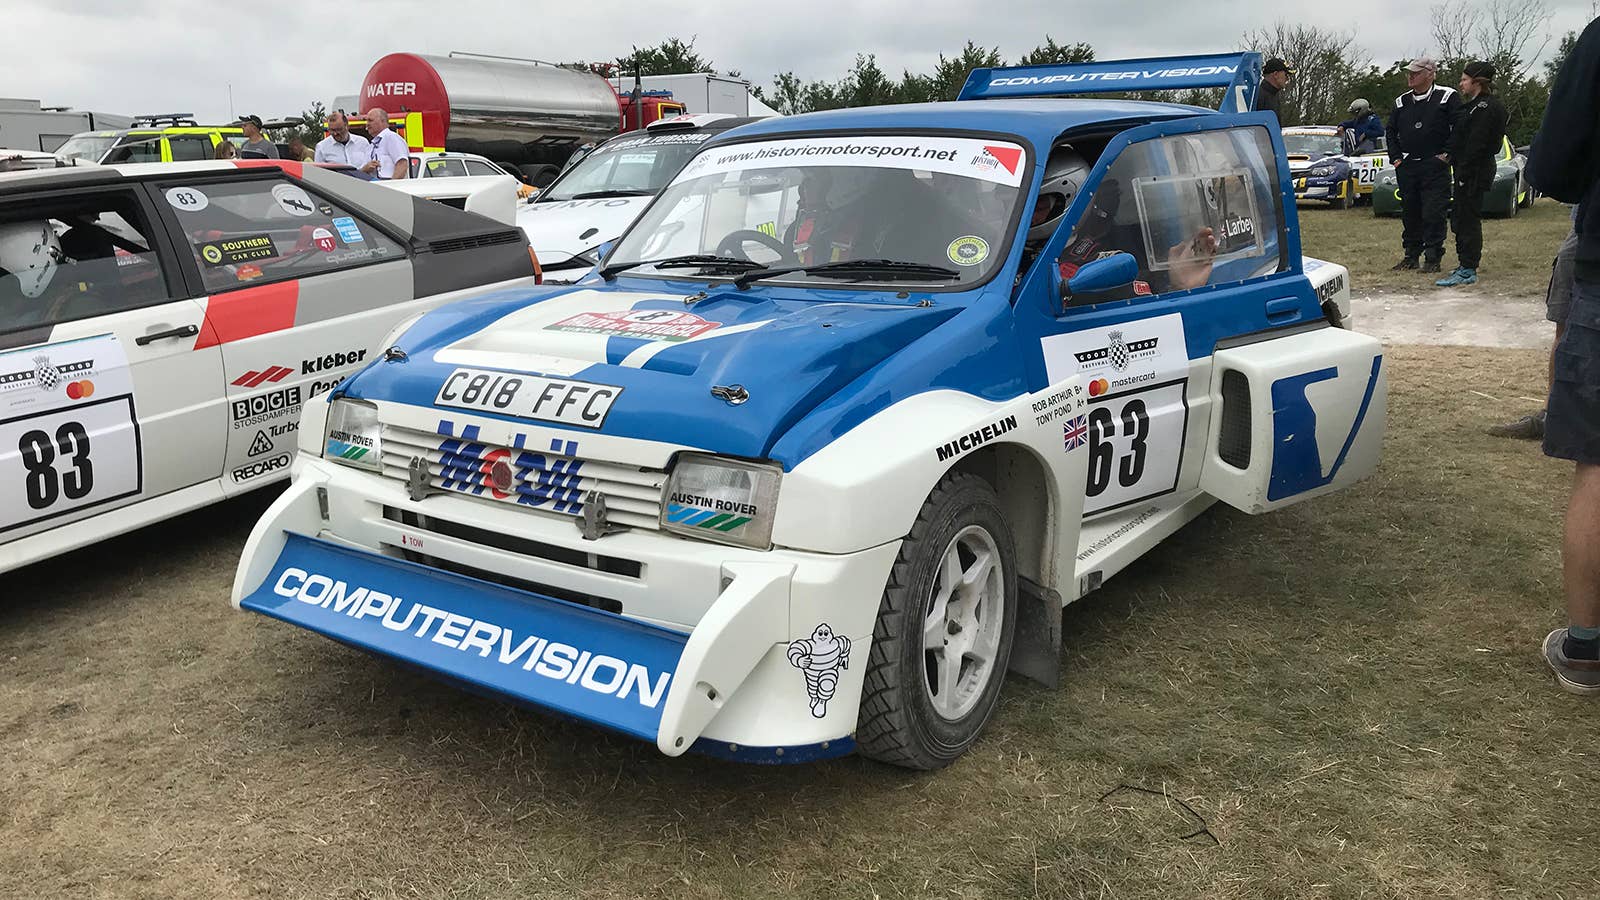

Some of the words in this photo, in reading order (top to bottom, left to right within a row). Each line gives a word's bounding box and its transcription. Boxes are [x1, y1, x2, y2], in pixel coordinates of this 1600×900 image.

[989, 65, 1239, 87] COMPUTERVISION
[367, 82, 417, 98] WATER
[716, 144, 959, 166] www.historicmotorsport.net
[176, 192, 197, 205] 83
[1225, 216, 1254, 237] Larbey
[221, 237, 271, 251] SOUTHERN
[231, 251, 249, 261] CAR
[252, 249, 271, 259] CLUB
[320, 239, 333, 249] 41
[325, 246, 388, 264] quattro
[1315, 274, 1344, 302] ICHELIN
[1079, 350, 1107, 361] GOOD
[1129, 340, 1156, 350] WOOD
[61, 361, 91, 373] WOOD
[301, 349, 367, 375] kléber
[1082, 360, 1109, 370] FESTIVAL
[1111, 371, 1156, 388] mastercard
[234, 387, 300, 420] BOGE
[441, 371, 516, 409] C818
[532, 383, 614, 422] FFC
[1032, 399, 1048, 413] ROB
[1048, 388, 1074, 407] ARTHUR
[1074, 385, 1083, 395] B+
[234, 404, 302, 430] STOSSDAMPFER
[1036, 411, 1054, 427] TONY
[1054, 403, 1072, 420] POND
[1077, 399, 1085, 408] A+
[329, 429, 351, 442] AUSTIN
[352, 434, 374, 447] ROVER
[936, 415, 1018, 462] MICHELIN
[1086, 399, 1150, 498] 63
[18, 421, 94, 510] 83
[233, 454, 289, 482] RECARO
[670, 492, 713, 508] AUSTIN
[715, 499, 757, 515] ROVER
[409, 537, 424, 548] TOW
[273, 567, 672, 708] COMPUTERVISION
